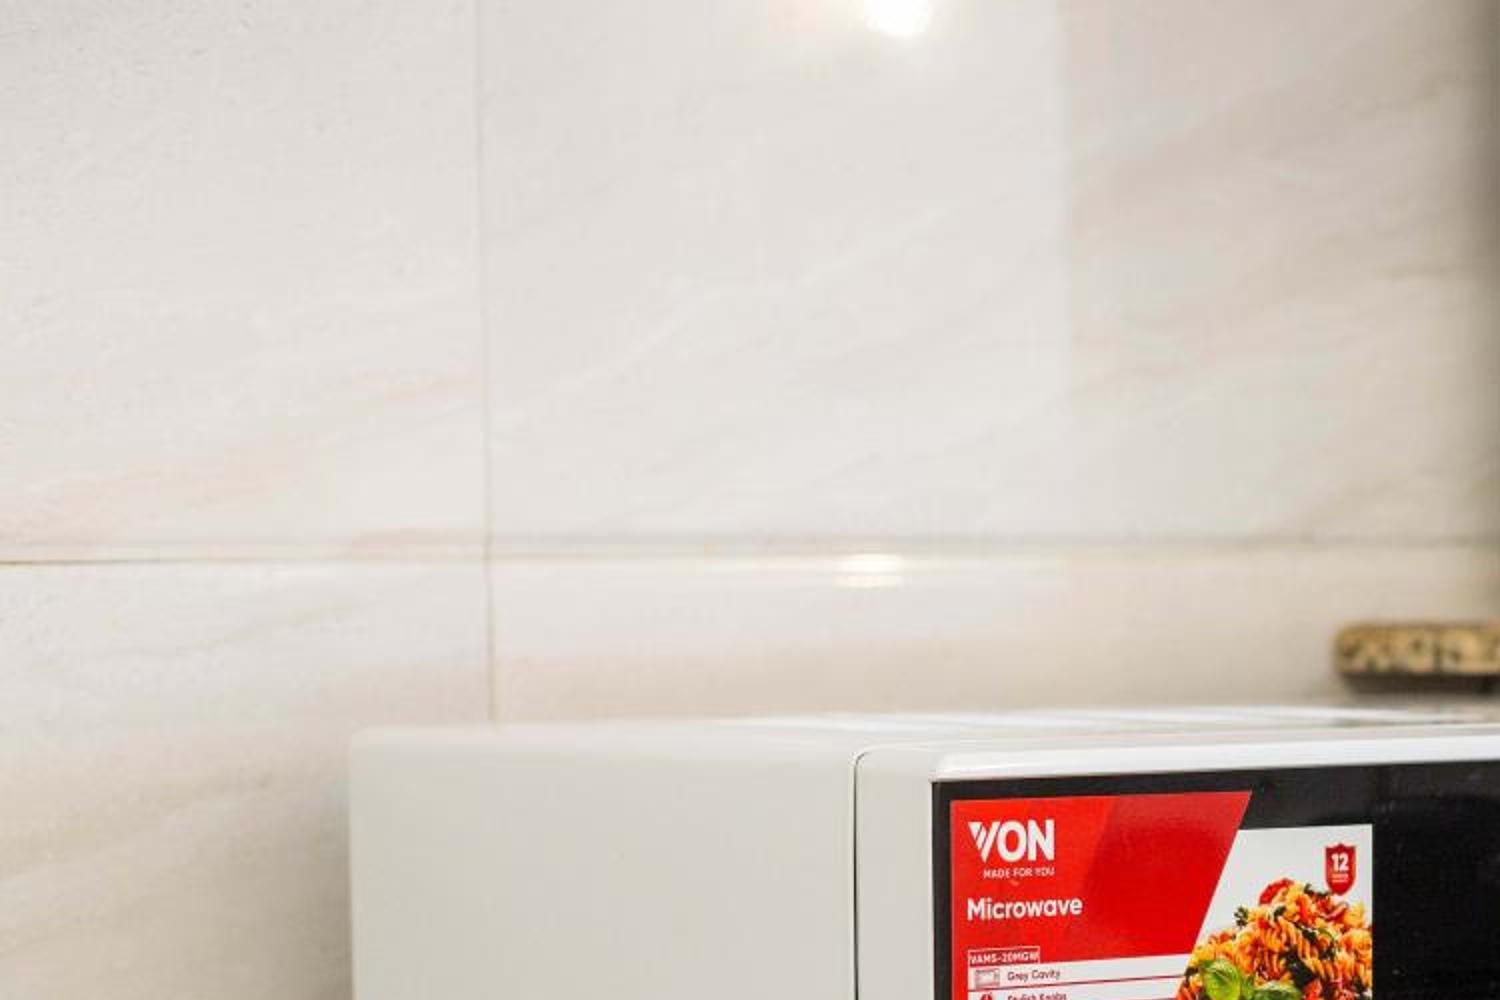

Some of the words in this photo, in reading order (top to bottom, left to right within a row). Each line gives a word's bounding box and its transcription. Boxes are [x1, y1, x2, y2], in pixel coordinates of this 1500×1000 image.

[968, 819, 1055, 863] VON
[1331, 853, 1349, 872] 12
[984, 868, 1010, 879] MADE
[1014, 867, 1033, 877] FOR
[1035, 866, 1055, 877] YOU
[967, 897, 1083, 921] Microwave
[1007, 971, 1028, 982] Grey
[1032, 969, 1060, 980] Cavity
